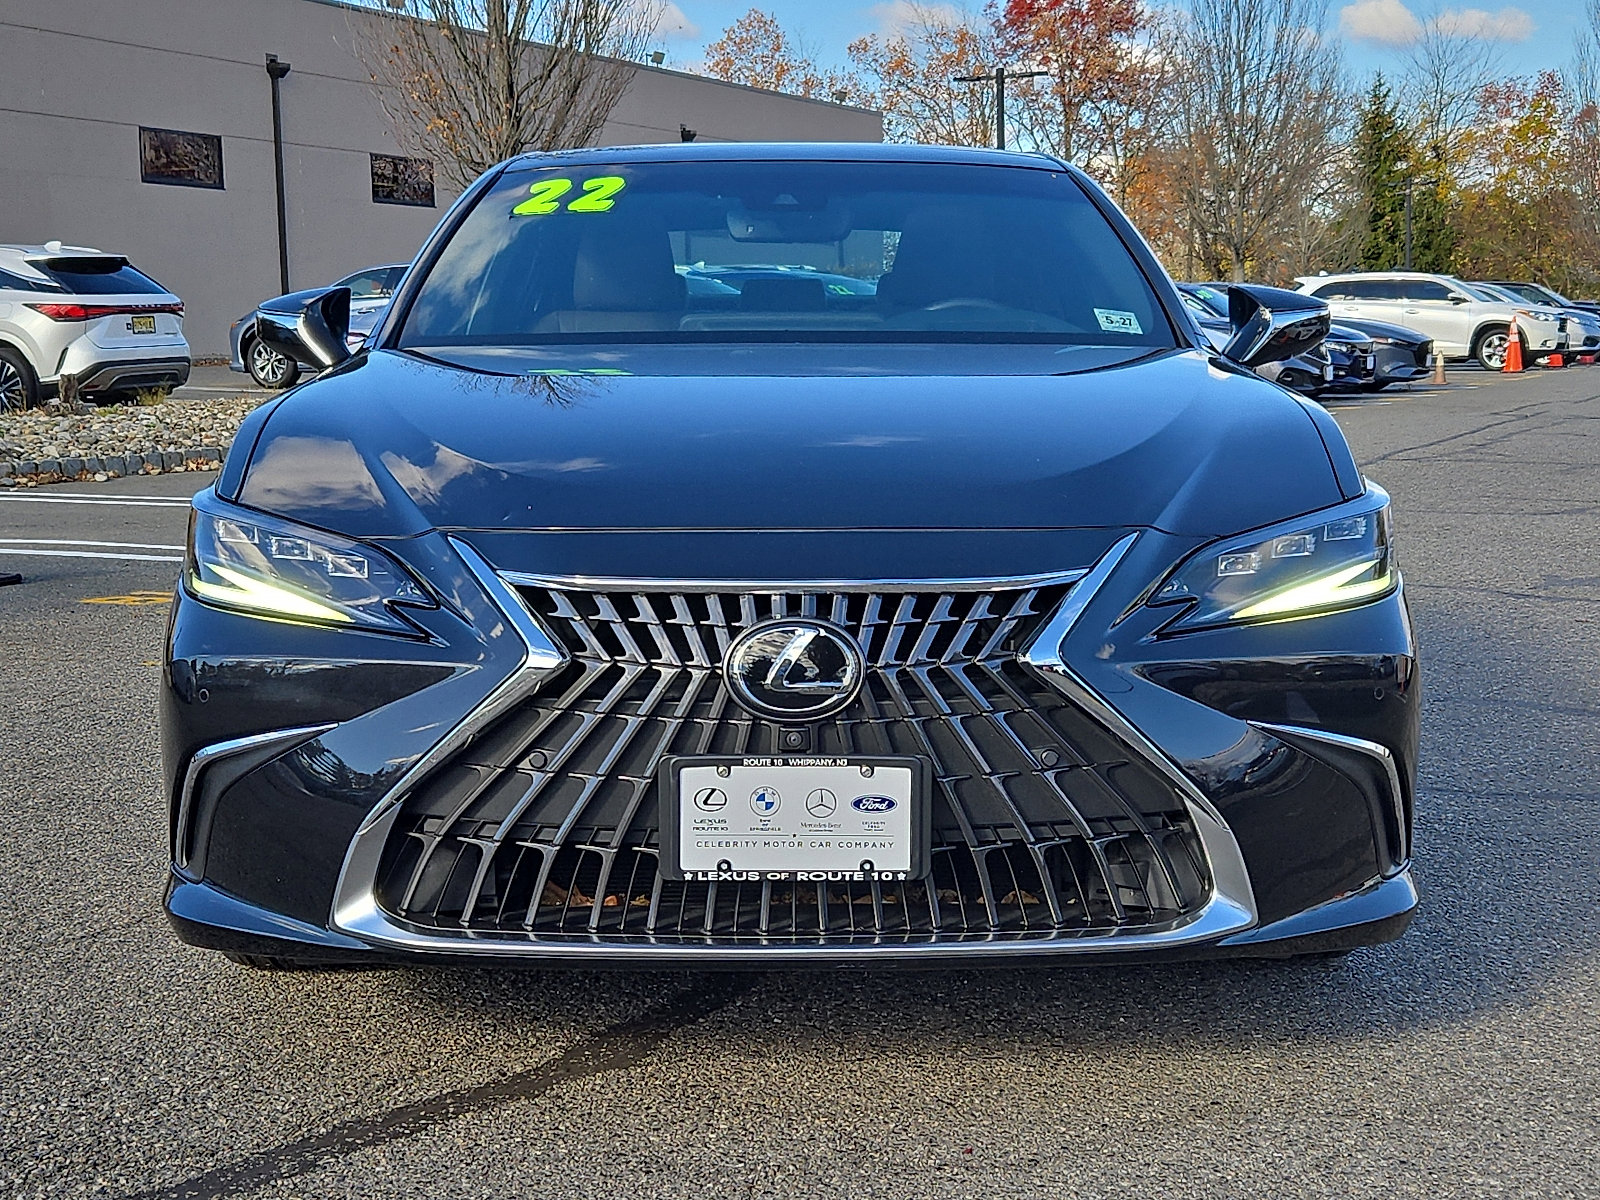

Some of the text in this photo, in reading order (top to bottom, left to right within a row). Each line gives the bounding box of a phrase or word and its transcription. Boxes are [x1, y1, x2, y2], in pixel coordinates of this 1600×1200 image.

[513, 176, 626, 215] 22
[1119, 317, 1132, 327] 27
[743, 758, 771, 767] ROUTE
[774, 758, 783, 767] 10
[788, 758, 835, 767] WHIPPANY,
[859, 798, 890, 810] Ford
[693, 818, 727, 826] LEXUS
[696, 841, 895, 849] CELEBRITY MOTOR CAR COMPANY
[697, 871, 893, 882] LEXUS OF ROUTE 10
